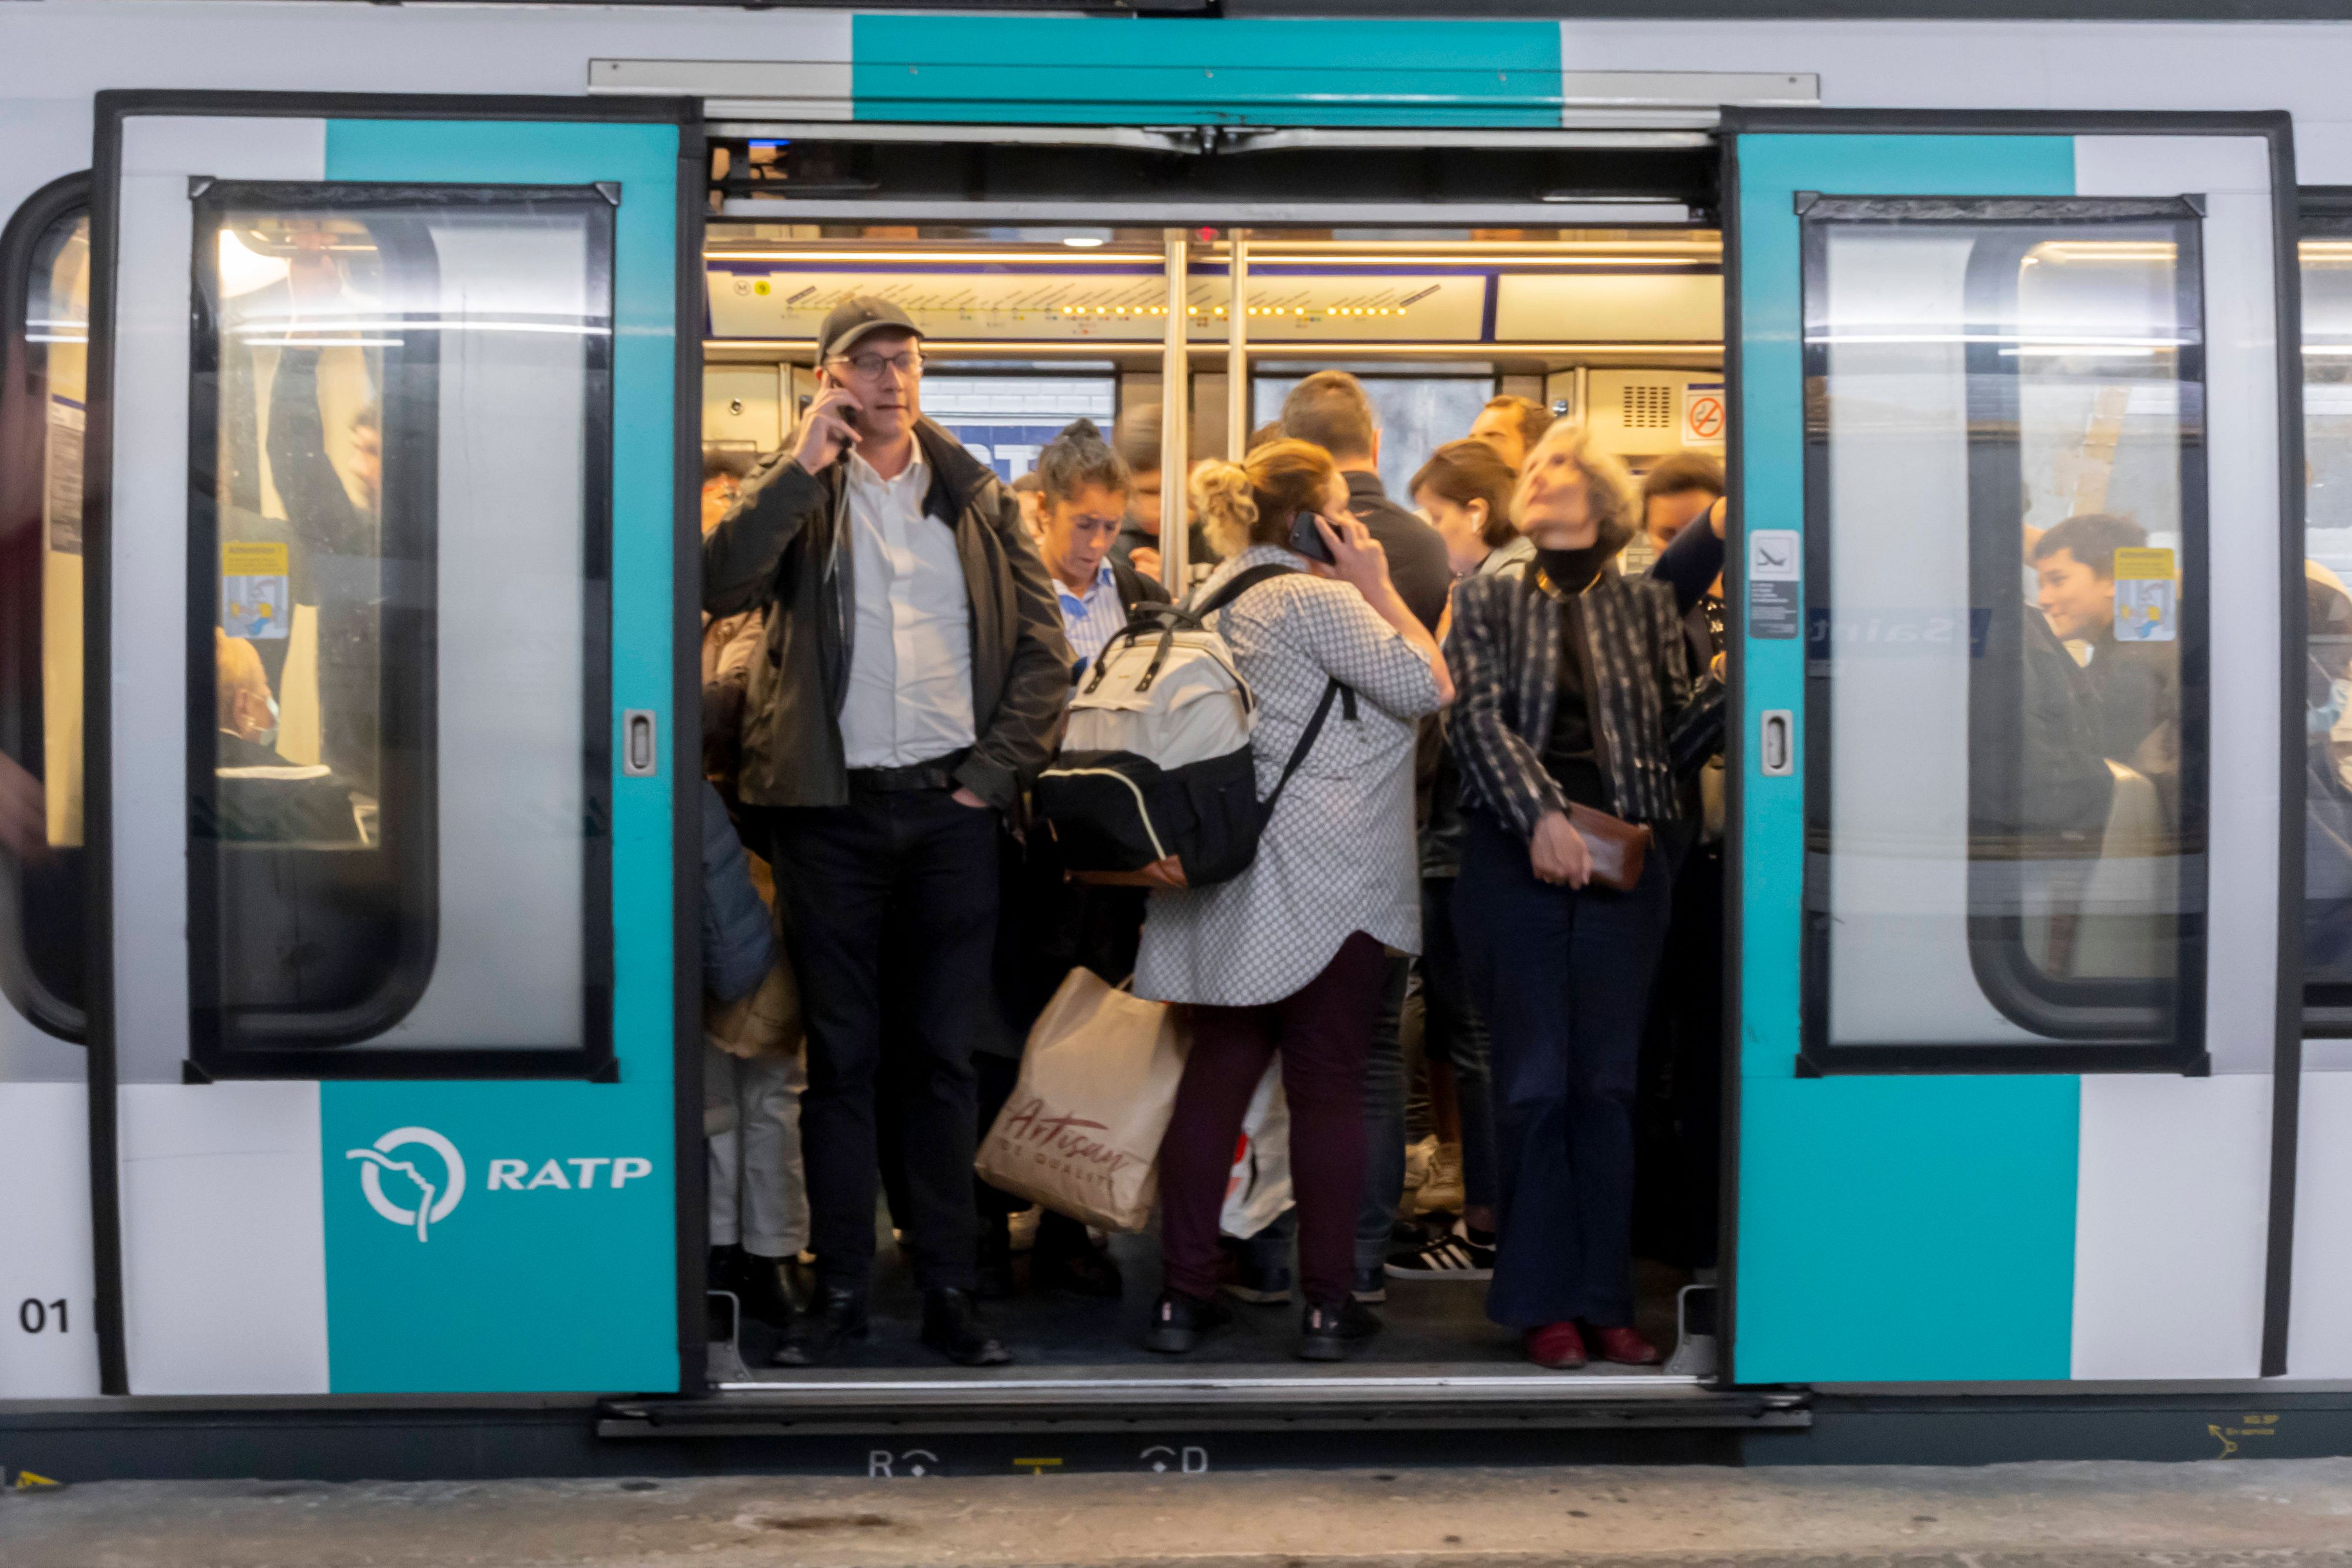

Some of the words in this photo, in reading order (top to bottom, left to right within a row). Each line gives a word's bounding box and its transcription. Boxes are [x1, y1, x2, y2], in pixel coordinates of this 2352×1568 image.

[1004, 1098, 1130, 1173] Artisan
[486, 1156, 653, 1191] RATP
[19, 1298, 69, 1334] 01
[869, 1450, 894, 1478] R
[1182, 1446, 1208, 1474] D
